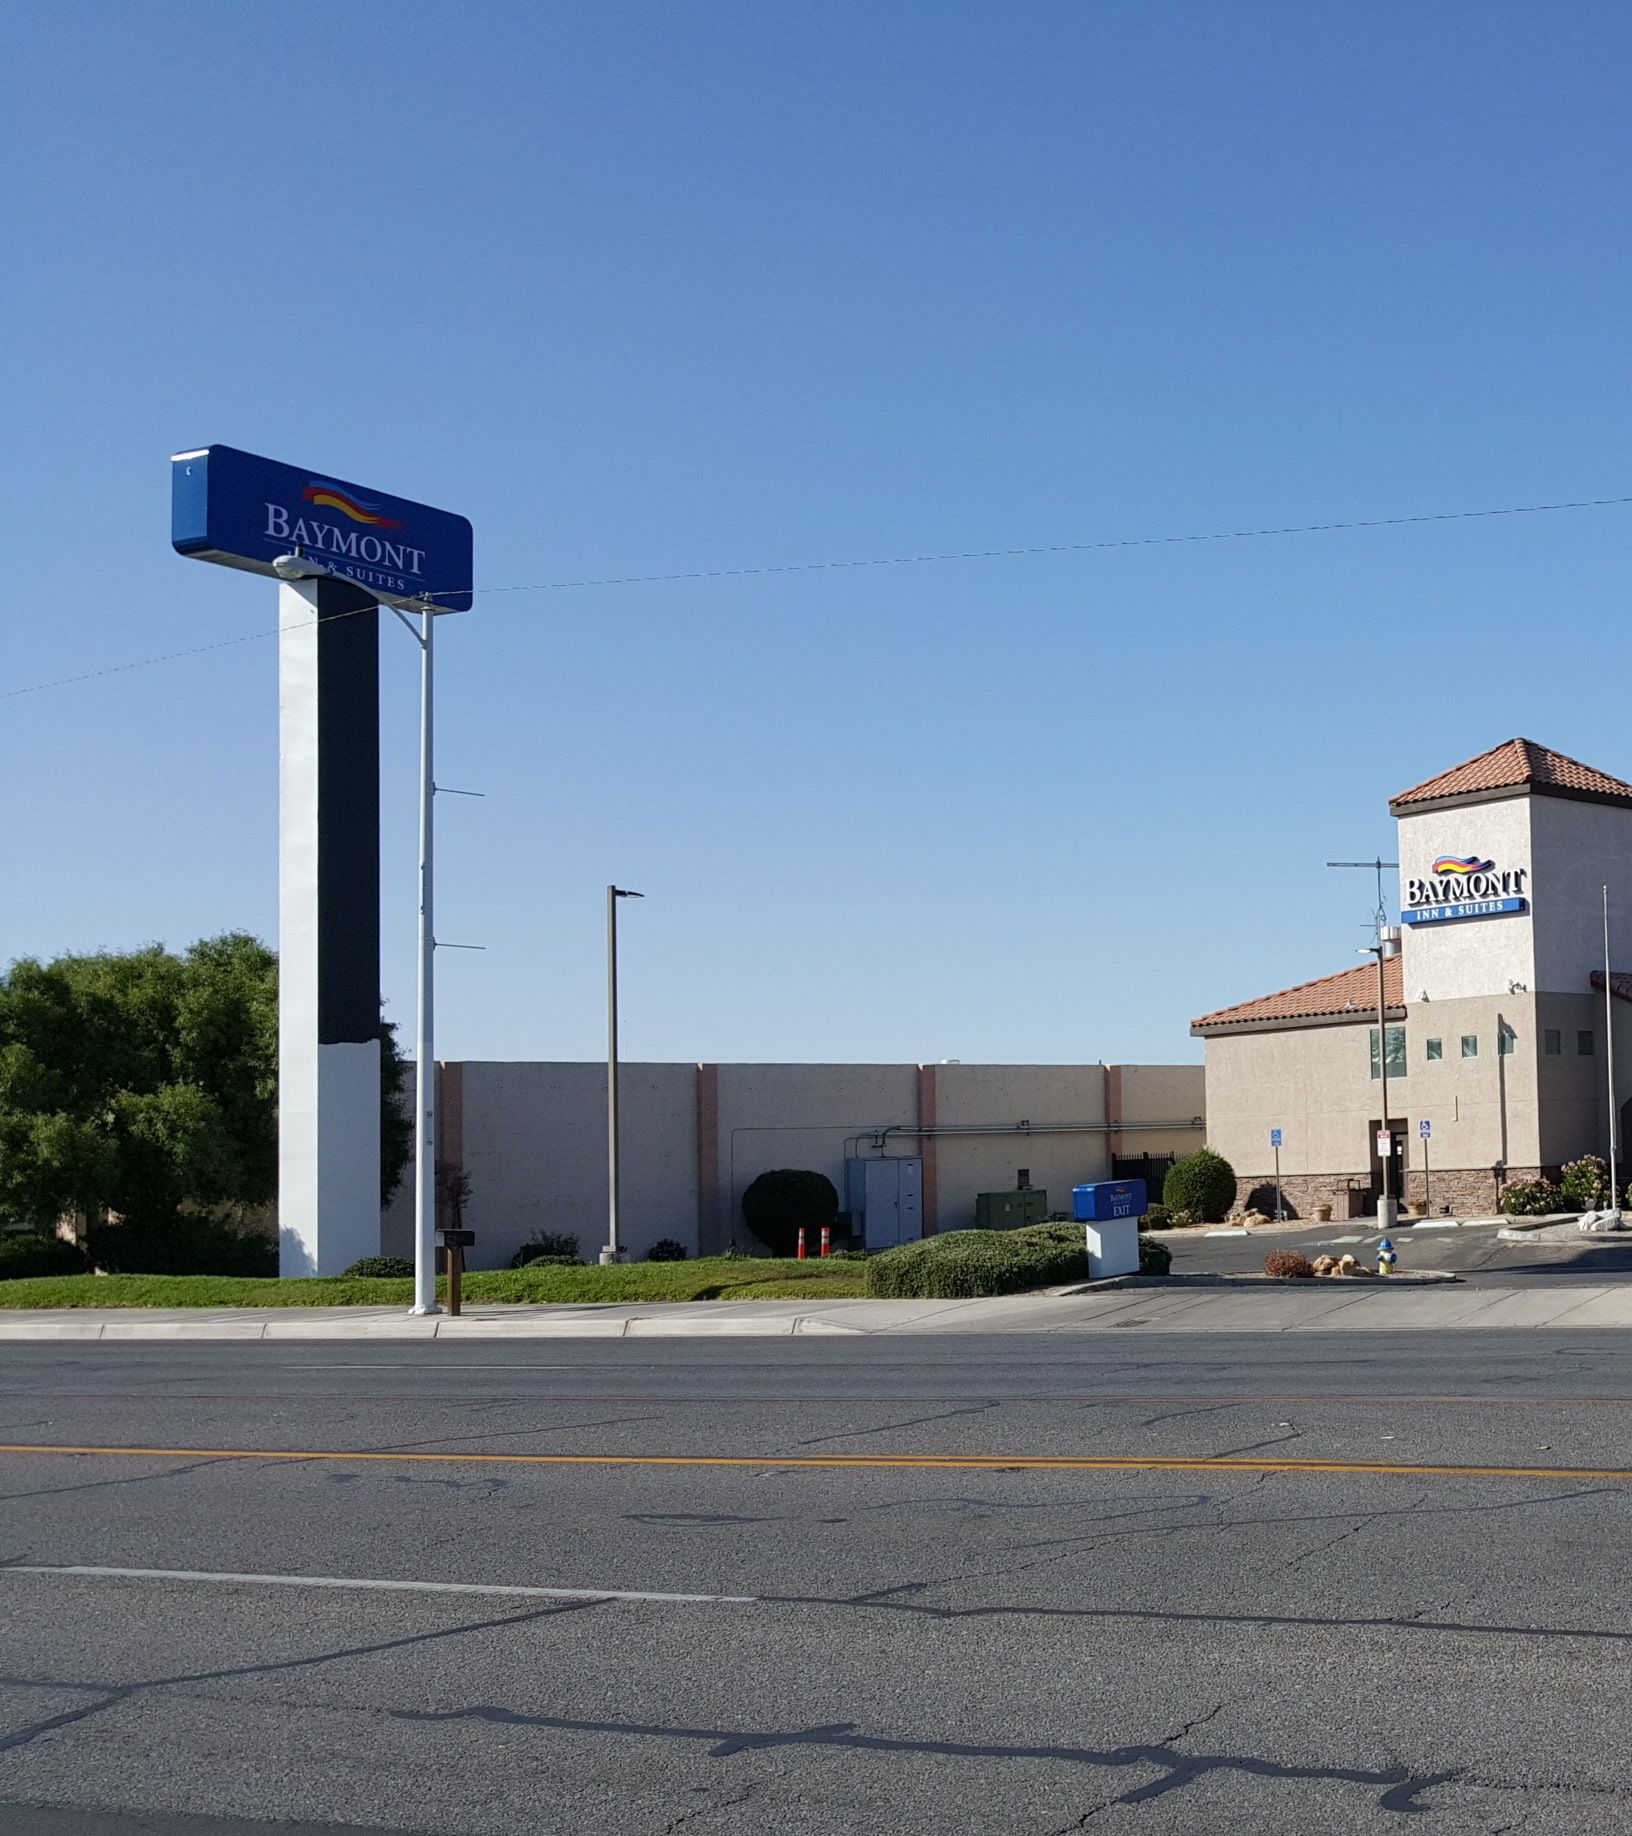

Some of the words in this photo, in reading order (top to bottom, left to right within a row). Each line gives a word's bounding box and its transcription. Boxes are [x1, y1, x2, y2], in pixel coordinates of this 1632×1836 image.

[264, 503, 425, 575] BAYMONT
[346, 566, 406, 590] SUITES
[1405, 869, 1525, 904] BAYMONT
[1416, 909, 1440, 921] INN
[1444, 907, 1453, 918] &
[1458, 900, 1504, 916] SUITES
[1113, 1204, 1130, 1217] EXIT
